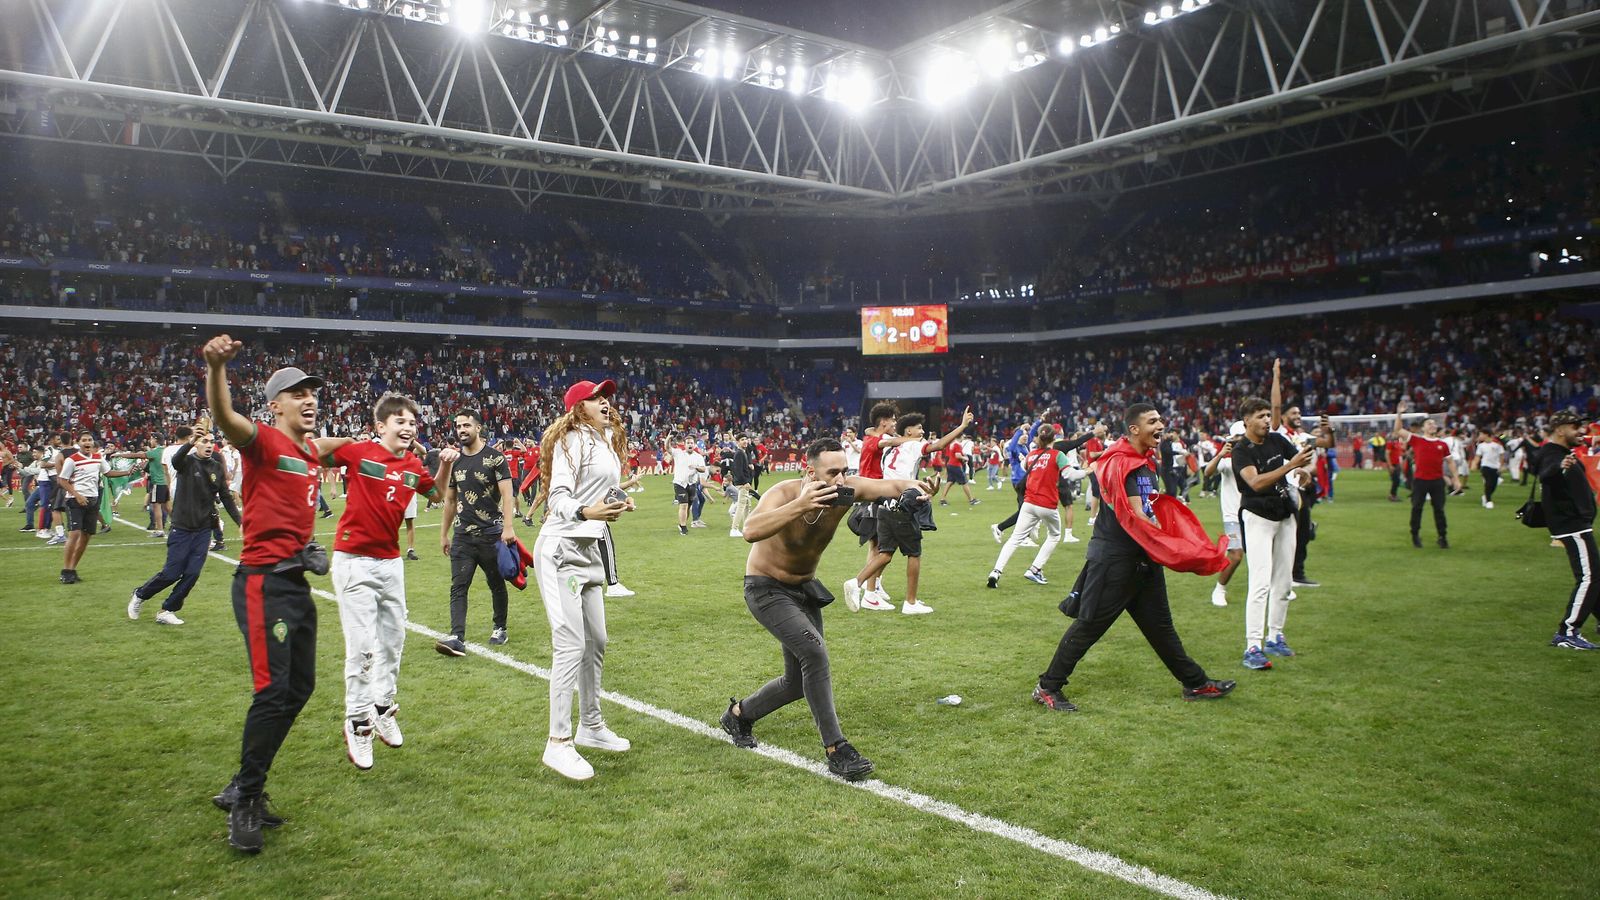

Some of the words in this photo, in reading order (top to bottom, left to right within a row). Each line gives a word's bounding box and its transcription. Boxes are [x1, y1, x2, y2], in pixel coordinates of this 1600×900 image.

[892, 307, 914, 317] 90:00
[307, 484, 315, 507] 2
[386, 486, 396, 502] 2
